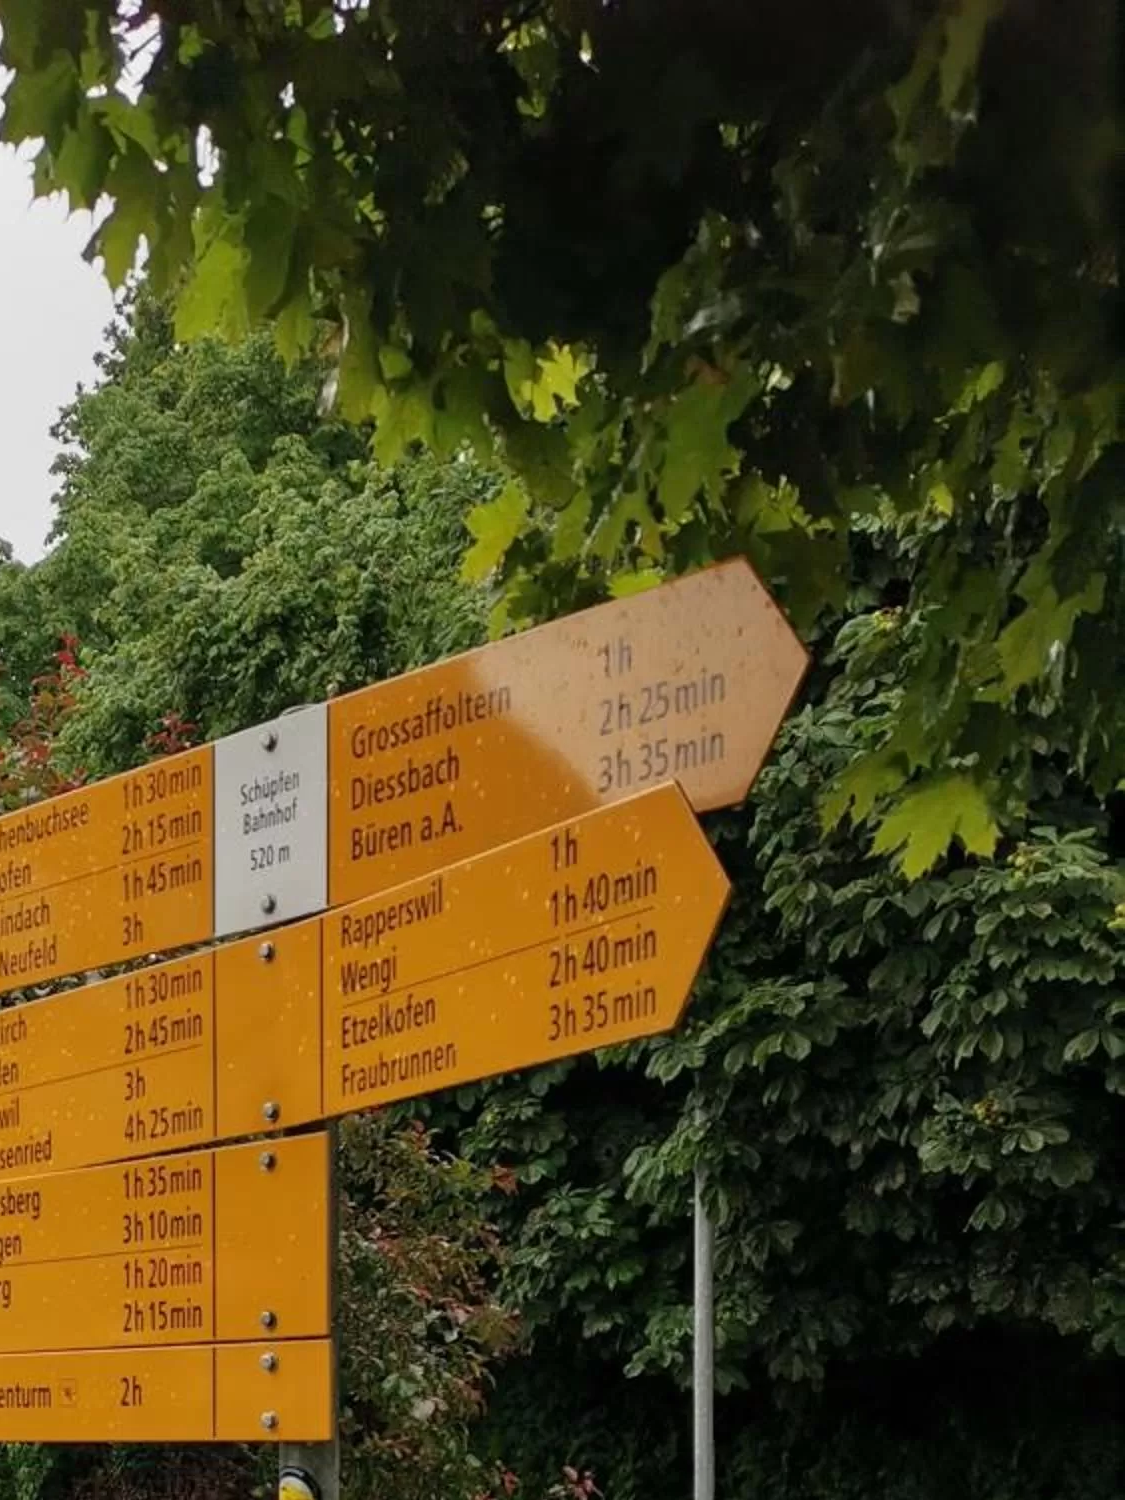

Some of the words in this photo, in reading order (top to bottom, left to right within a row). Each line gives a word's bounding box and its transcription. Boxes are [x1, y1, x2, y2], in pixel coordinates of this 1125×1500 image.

[351, 684, 511, 759] Grossaffoltern
[240, 769, 300, 807] Schüpfen
[351, 745, 460, 811] Diessbach
[243, 798, 297, 835] Bahnhof
[351, 814, 412, 861] Büren
[250, 844, 274, 871] 520
[341, 879, 443, 949] Rapperswil
[341, 946, 397, 995] Wengi
[342, 995, 436, 1049] Etzelkofen
[342, 1039, 456, 1097] Fraubrunnen
